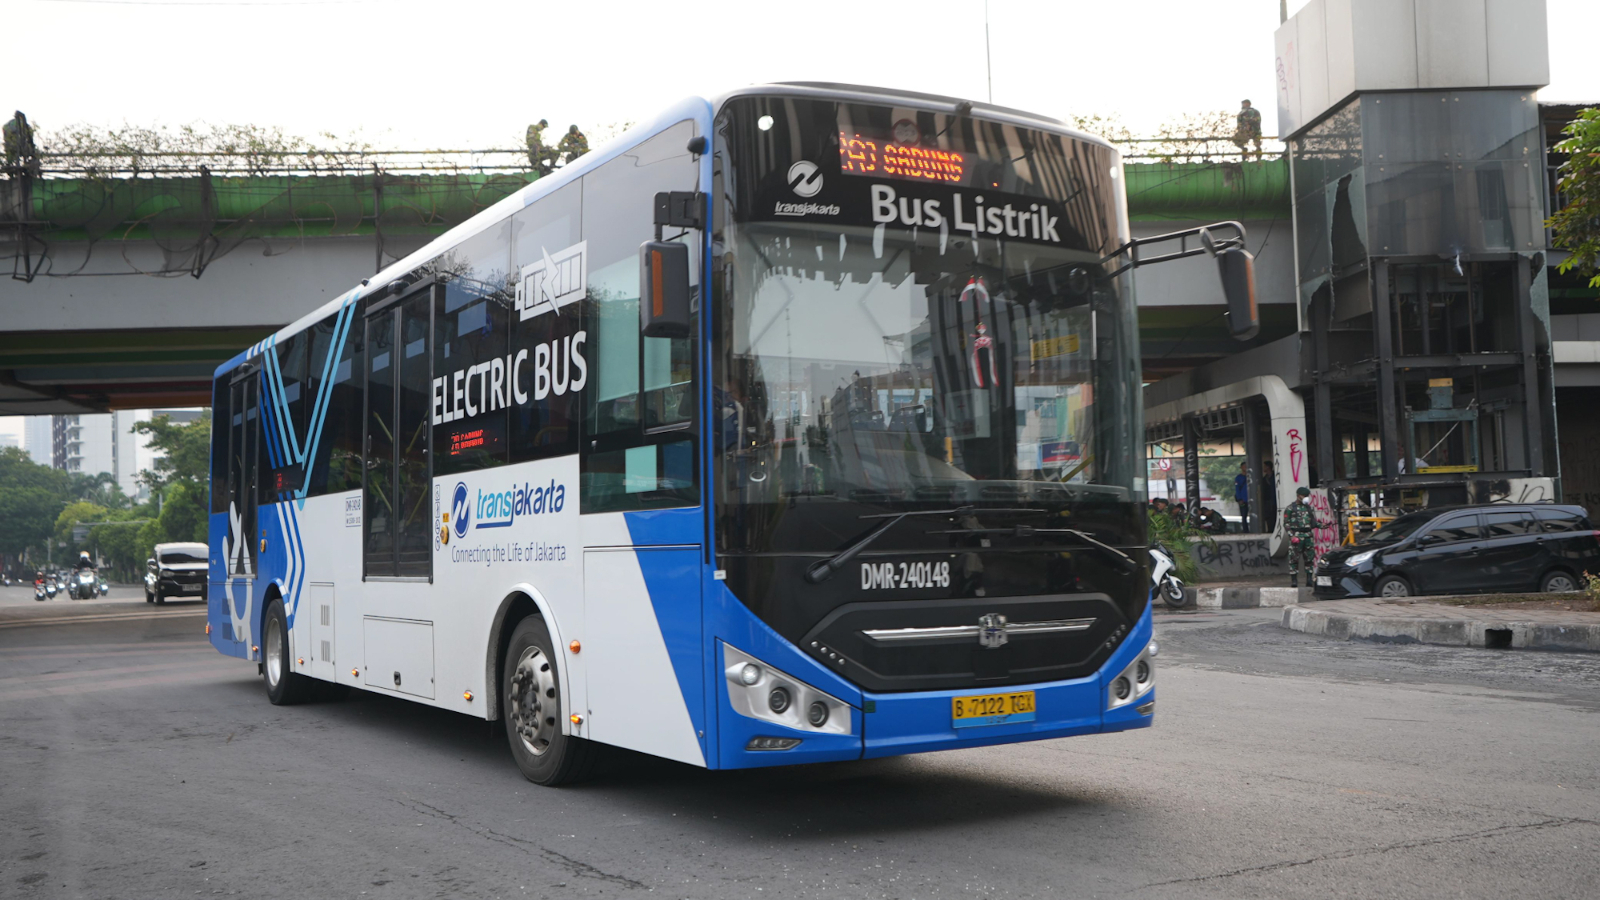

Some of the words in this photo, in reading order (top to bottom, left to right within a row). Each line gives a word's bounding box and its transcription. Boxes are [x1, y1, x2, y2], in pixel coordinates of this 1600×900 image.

[774, 201, 840, 216] transjakarta
[871, 184, 942, 228] Bus
[953, 193, 1061, 242] Listrik
[432, 348, 528, 426] ELECTRIC
[534, 330, 588, 400] BUS
[475, 478, 566, 529] transjakarta
[451, 545, 491, 568] Connecting
[492, 544, 506, 563] the
[507, 542, 522, 562] Life
[525, 542, 534, 561] of
[535, 541, 566, 562] Jakarta
[1237, 540, 1269, 554] DPR
[861, 561, 950, 590] DMR-240148
[955, 700, 964, 717] B
[971, 697, 1005, 716] 7122
[1010, 693, 1033, 713] TGX
